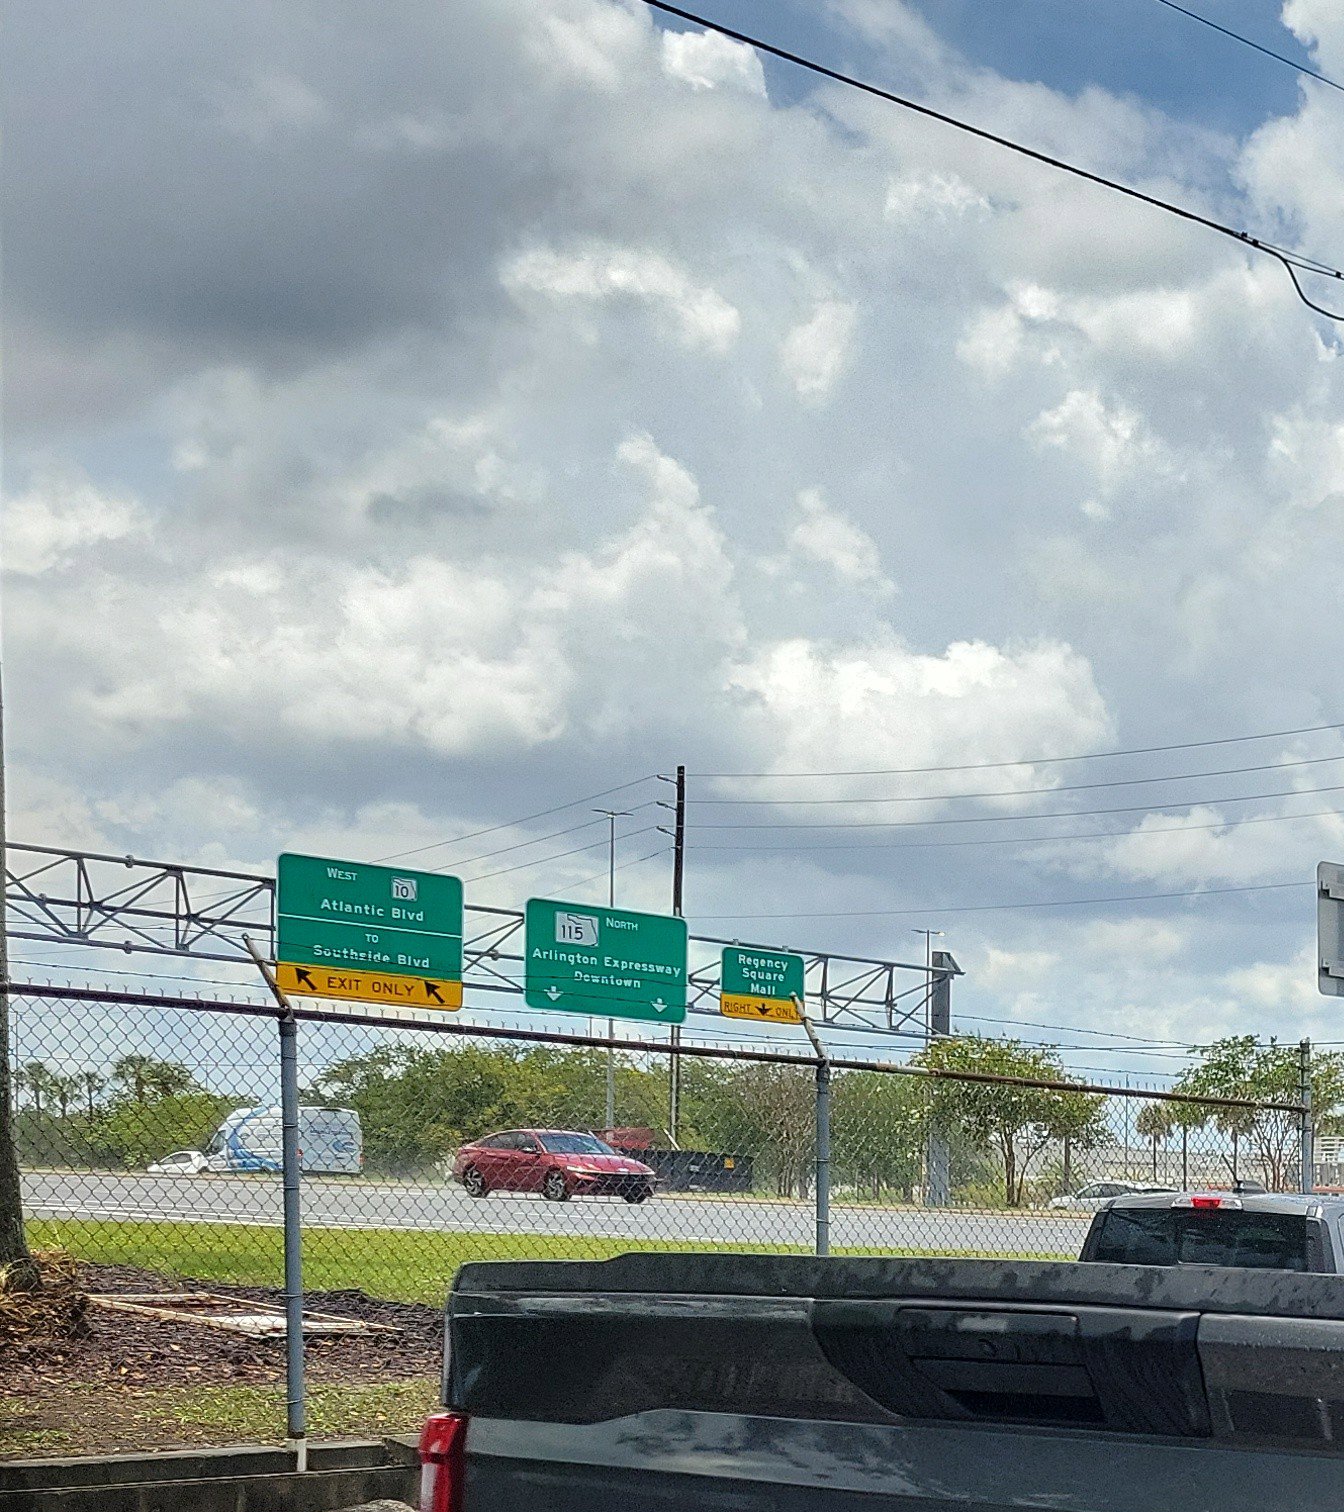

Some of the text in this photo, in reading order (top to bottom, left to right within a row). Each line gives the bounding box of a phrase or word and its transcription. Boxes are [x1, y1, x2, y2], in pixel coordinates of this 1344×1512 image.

[326, 867, 357, 881] WEST
[395, 885, 409, 898] 10
[320, 898, 424, 922] Atlantic Blvd
[606, 917, 638, 931] NORTH
[365, 933, 379, 944] TO
[561, 924, 584, 941] 115
[313, 944, 430, 968] Southside Blvd
[532, 947, 681, 978] Arlington Expressway
[738, 953, 788, 972] Regency
[574, 970, 641, 988] Downtown
[742, 967, 785, 982] Square
[327, 976, 415, 997] EXIT ONLY
[750, 983, 776, 996] Mall
[724, 1001, 751, 1013] RIGHT
